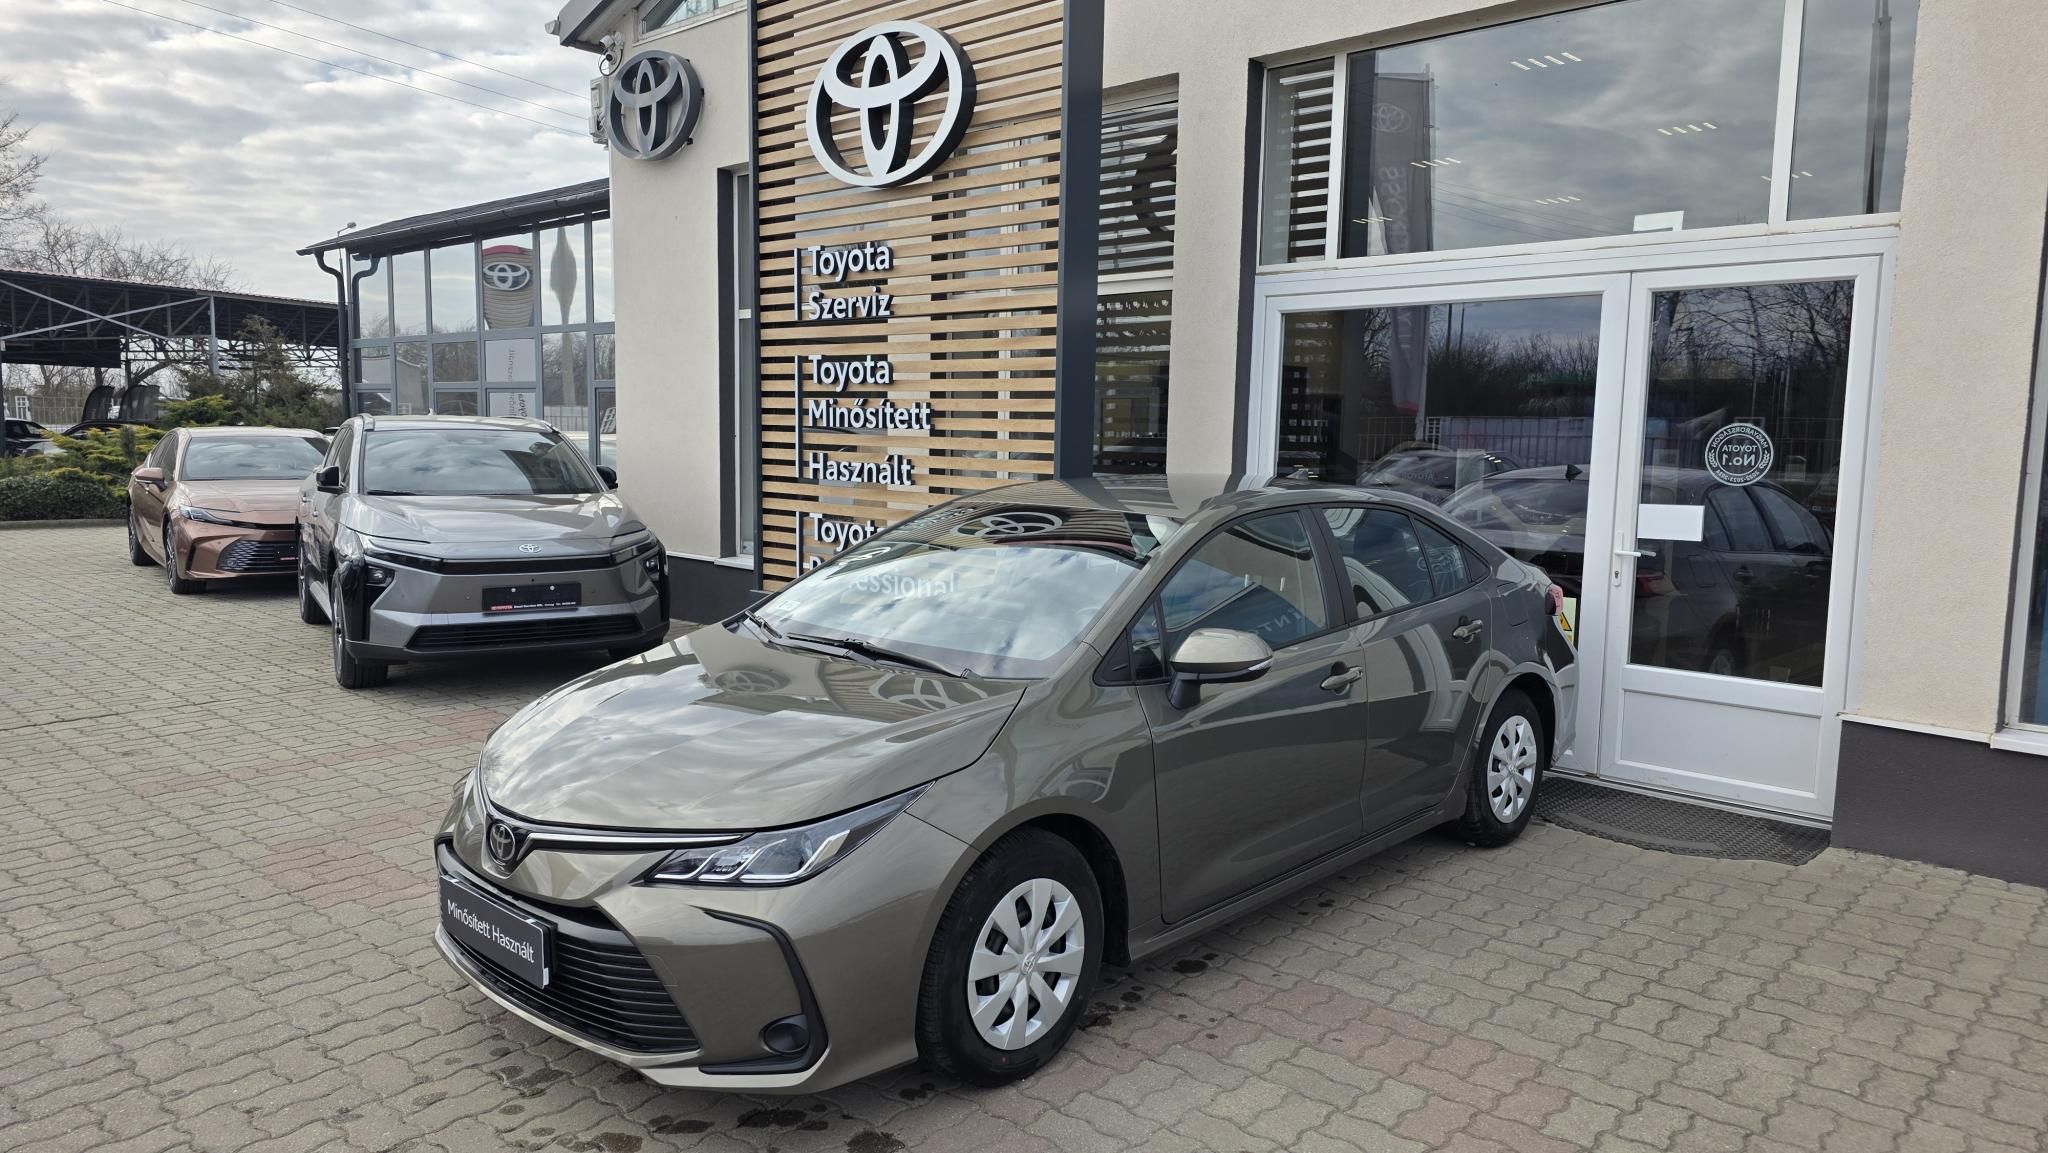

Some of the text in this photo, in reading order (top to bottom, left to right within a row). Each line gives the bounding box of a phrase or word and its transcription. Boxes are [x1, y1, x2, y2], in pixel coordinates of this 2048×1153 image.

[808, 242, 890, 281] Toyota
[808, 287, 891, 321] Szerviz
[808, 355, 890, 392] Toyota
[808, 398, 931, 430] Minősített
[808, 452, 912, 486] Használt
[809, 512, 885, 551] Toyot
[447, 899, 535, 963] Minősített Használt
